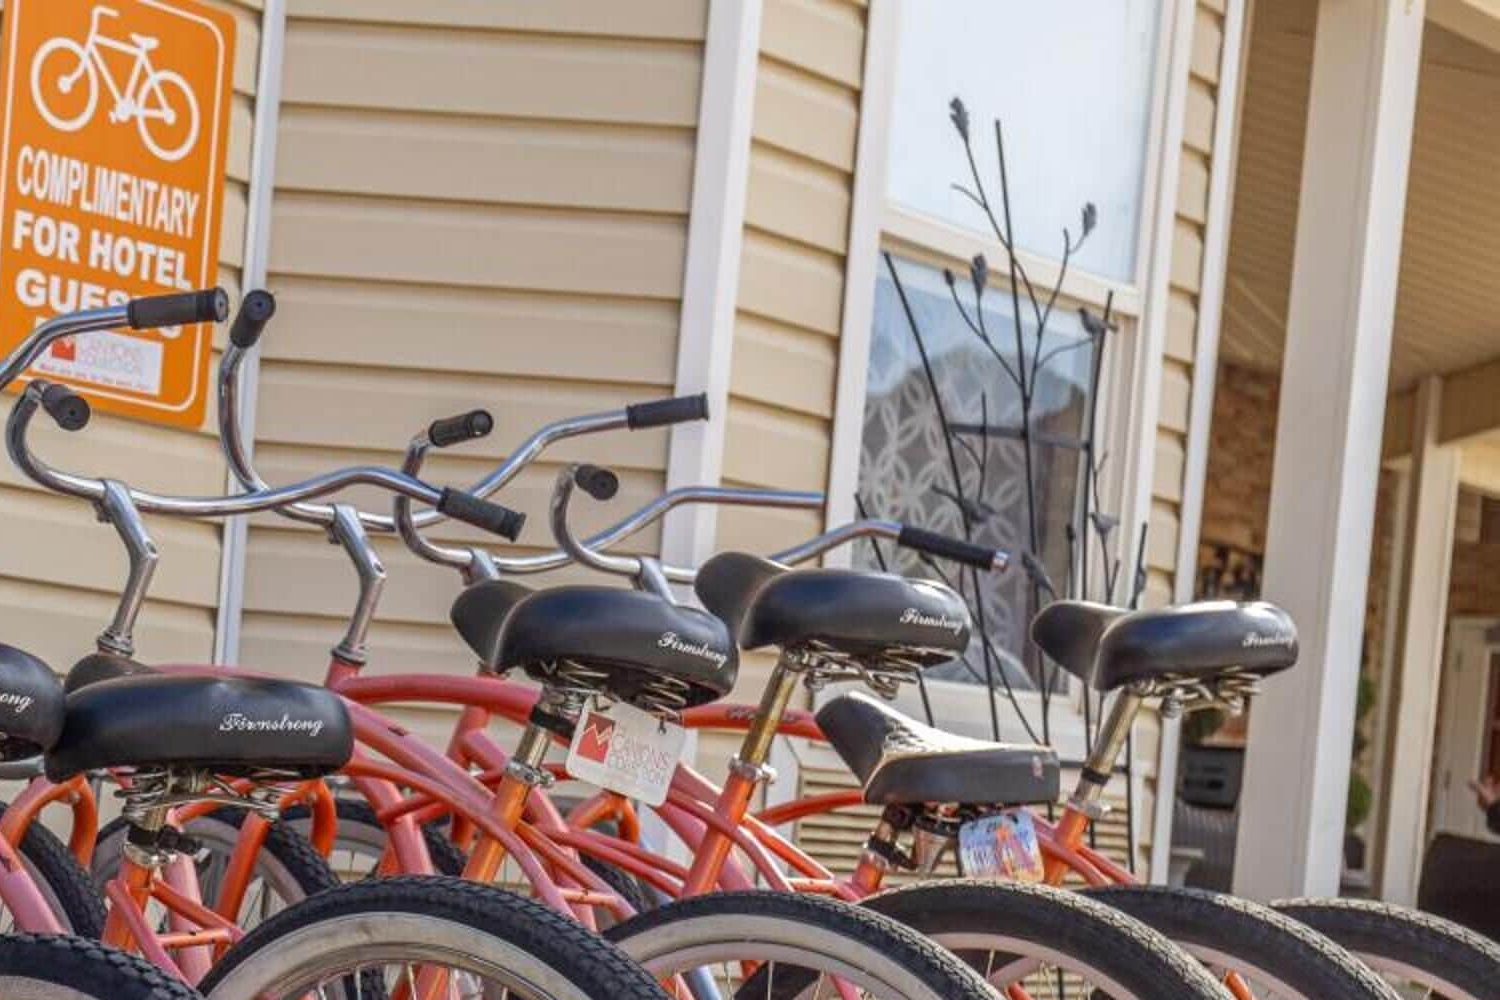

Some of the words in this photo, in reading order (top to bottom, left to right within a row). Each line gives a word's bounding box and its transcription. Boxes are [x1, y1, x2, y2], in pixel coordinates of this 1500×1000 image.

[16, 144, 199, 238] COMPLIMENTARY
[12, 209, 80, 264] FOR
[88, 228, 192, 290] HOTEL
[657, 631, 728, 669] Firmstrong
[219, 712, 323, 736] Firmstrong
